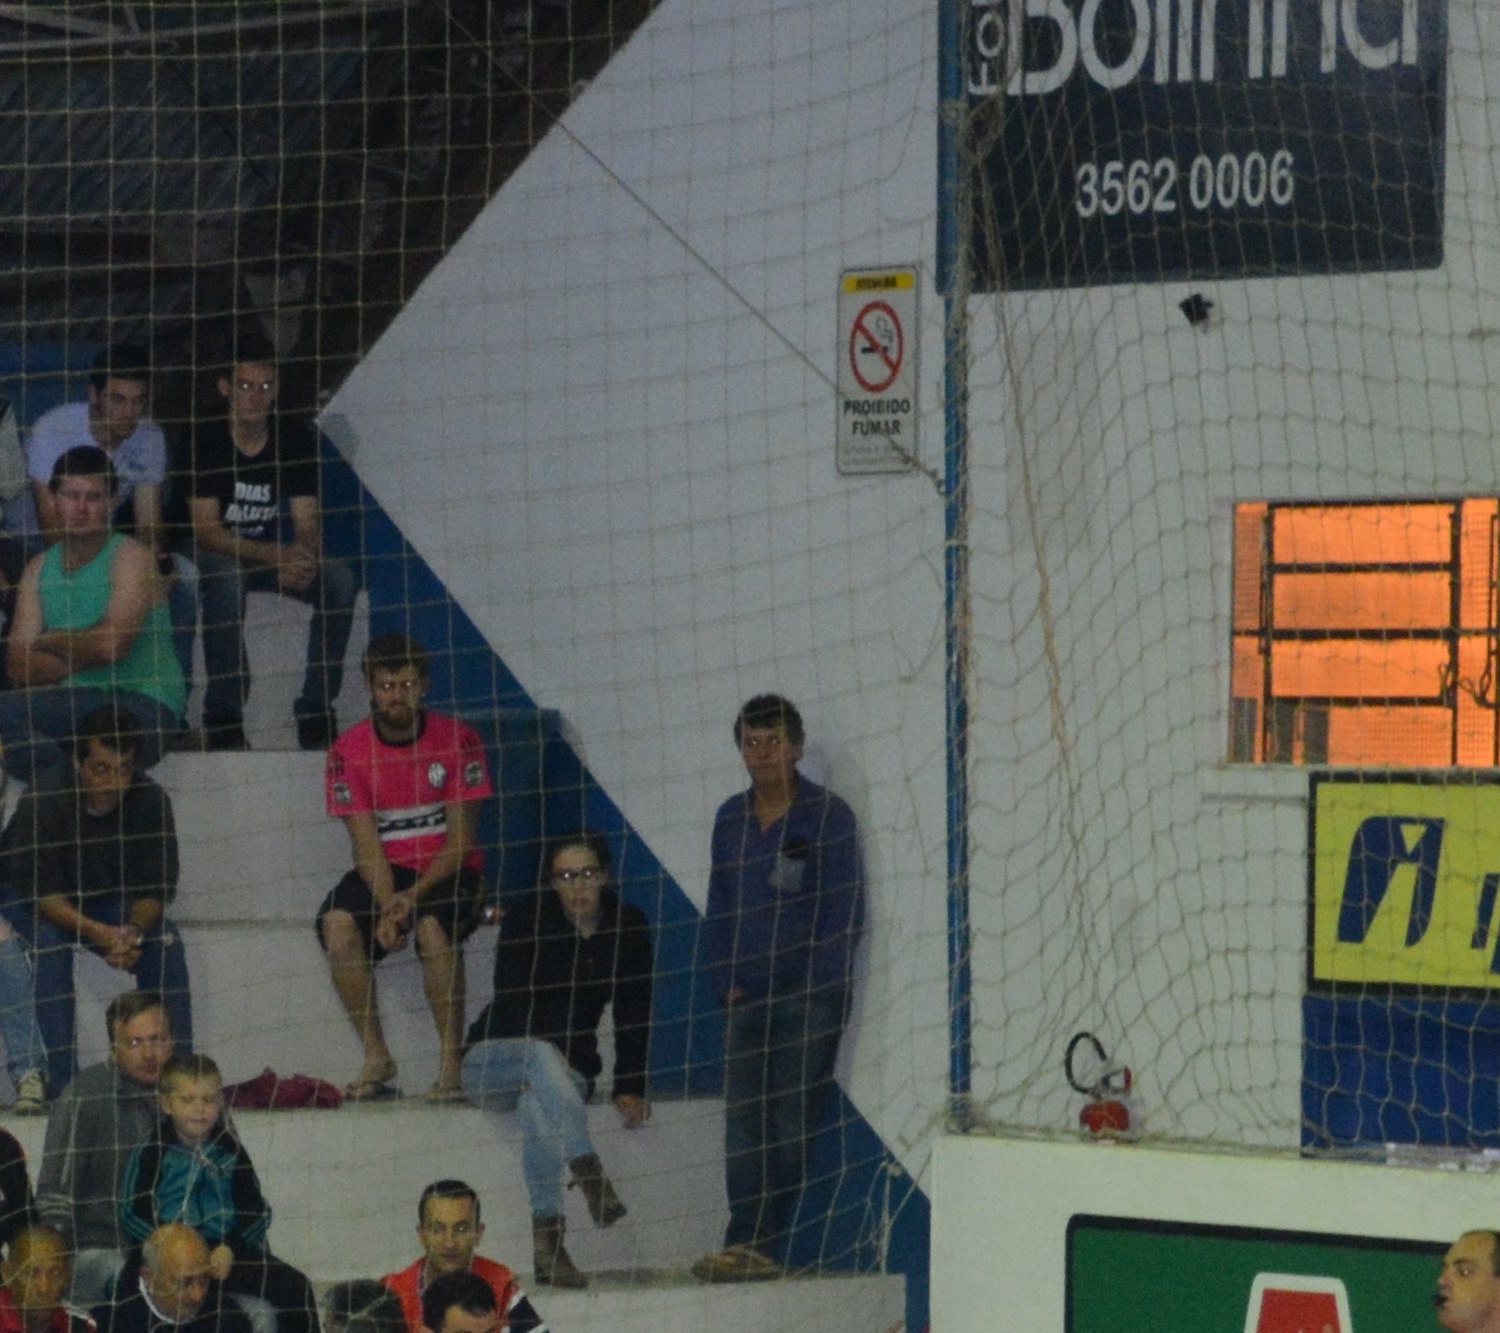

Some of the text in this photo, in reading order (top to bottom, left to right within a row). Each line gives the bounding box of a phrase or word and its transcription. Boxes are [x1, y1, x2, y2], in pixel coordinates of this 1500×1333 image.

[1076, 150, 1294, 218] 3562 0006
[843, 399, 911, 415] PROIBIDO
[851, 419, 902, 436] FUMAR
